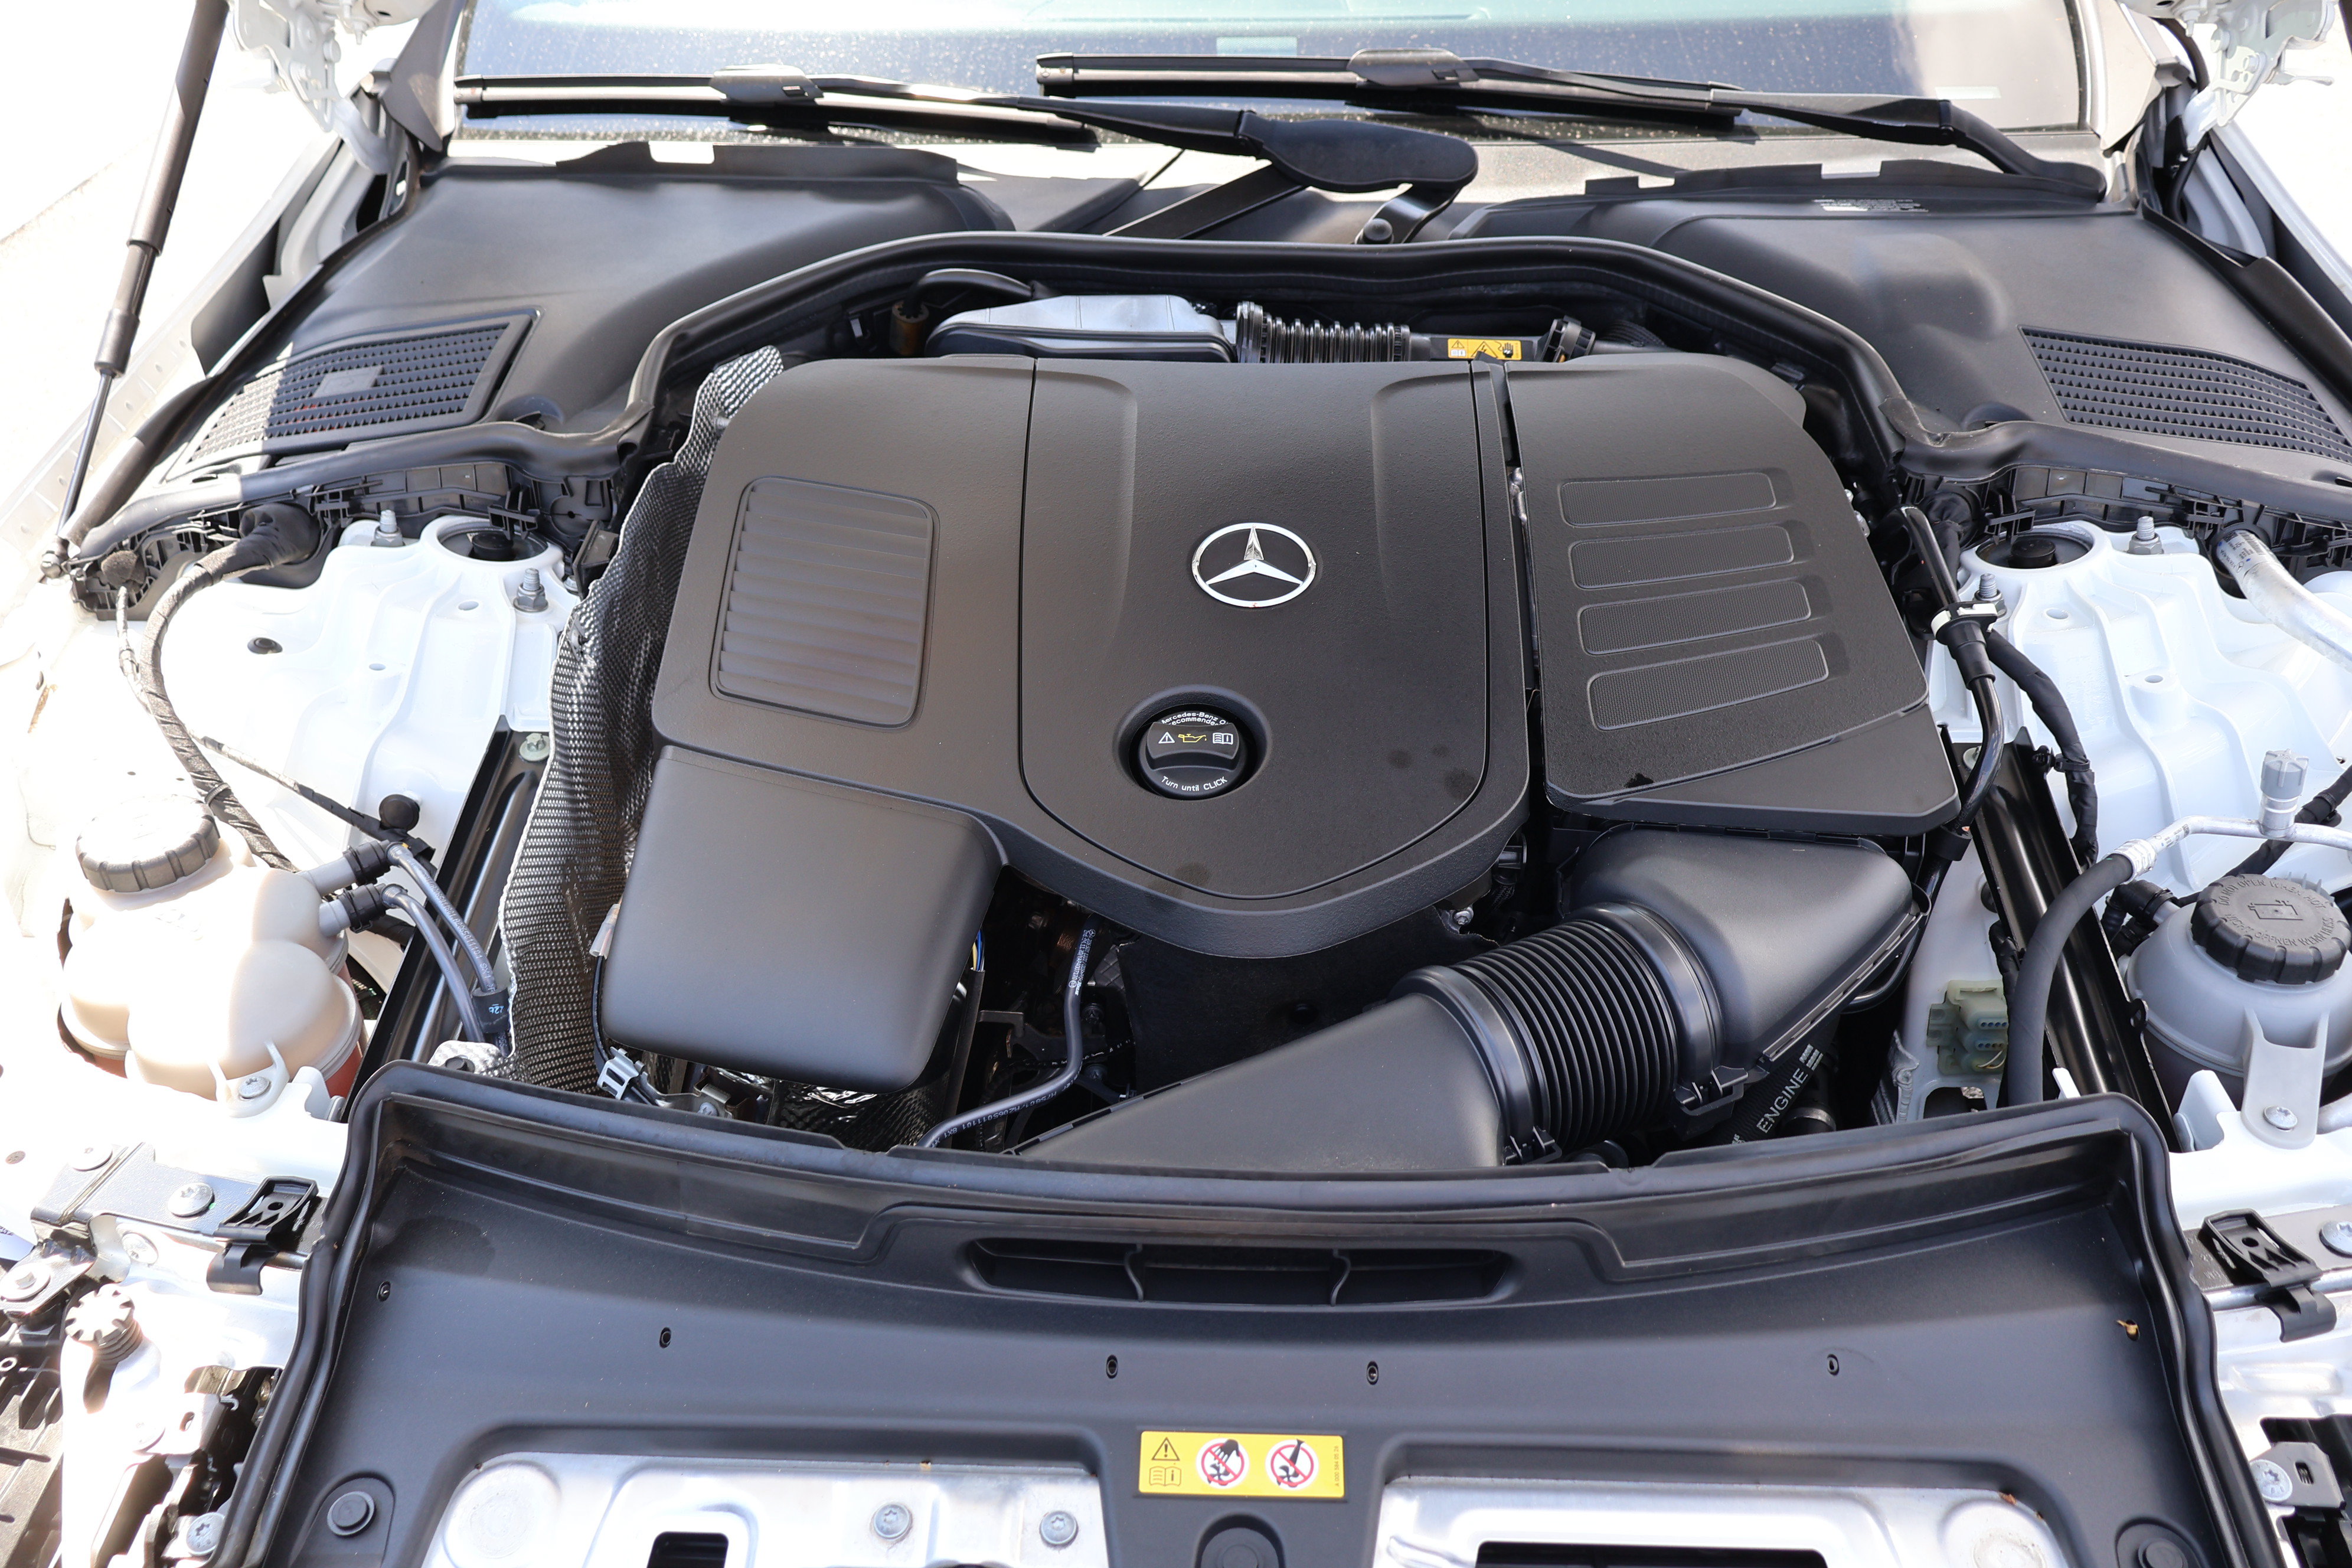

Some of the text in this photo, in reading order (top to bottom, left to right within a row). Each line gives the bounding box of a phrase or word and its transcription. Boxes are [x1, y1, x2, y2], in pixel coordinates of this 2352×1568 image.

[1161, 776, 1178, 789] Turn
[1203, 776, 1227, 790] CLICK
[2219, 879, 2326, 909] DO NOT OPEN WHEN HOT
[2225, 913, 2254, 932] NICHT
[2298, 932, 2325, 946] WENN
[2321, 916, 2334, 936] HEISS
[1756, 1068, 1808, 1133] ENGINE
